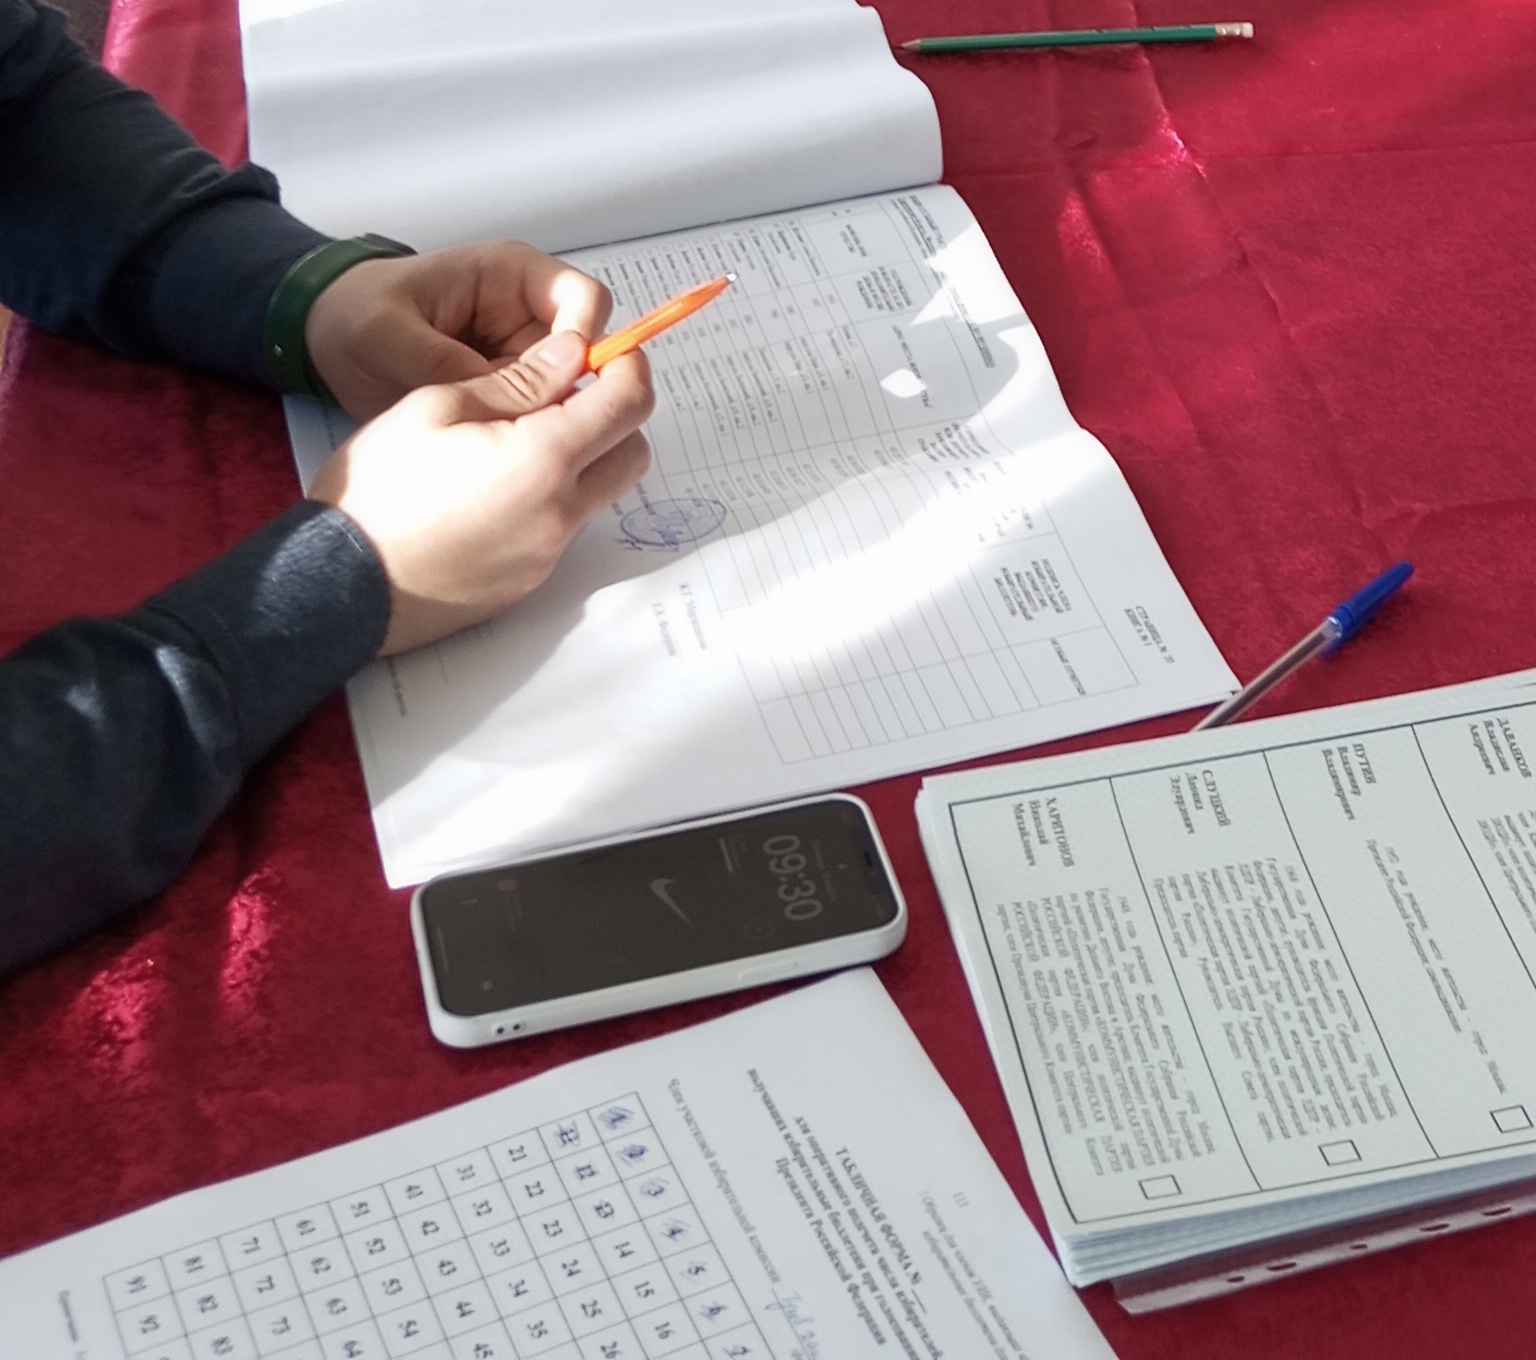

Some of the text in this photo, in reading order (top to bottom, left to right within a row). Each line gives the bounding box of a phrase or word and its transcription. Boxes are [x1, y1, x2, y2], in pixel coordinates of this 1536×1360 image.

[1322, 749, 1354, 819] Владимирович
[1338, 747, 1361, 795] Владимир
[1353, 744, 1376, 783] ПУТИН
[1471, 725, 1495, 774] Андреевич
[1484, 721, 1510, 771] Владислав
[1497, 718, 1531, 777] ДАВАНКОВ
[1014, 803, 1035, 865] Михайлович
[1029, 801, 1048, 844] Николай
[1047, 798, 1074, 867] ХАРИТОНОВ
[1171, 776, 1195, 834] Эдуардович
[1186, 773, 1203, 810] Леонид
[1203, 770, 1230, 826] СЛУЦКИЙ
[762, 833, 824, 922] 09:30
[668, 1079, 780, 1283] Член участковой избирательной комиссии
[748, 1069, 787, 1131] получивших
[784, 1133, 831, 1210] избирательные
[829, 1212, 866, 1270] бюллетени
[863, 1272, 879, 1292] при
[808, 1136, 850, 1206] оперативного
[848, 1208, 879, 1255] подсчета
[878, 1257, 898, 1289] числа
[836, 1148, 886, 1222] ТАБЛИЧНАЯ
[881, 1224, 912, 1270] ФОРМА
[245, 1237, 290, 1334] 71 72 73
[297, 1220, 362, 1358] 61 62 63 64
[352, 1202, 418, 1338] 51 52 53 54
[406, 1186, 493, 1358] 41 42 43 44 45
[457, 1165, 548, 1338] 31 32 33 34 35
[509, 1146, 619, 1358] 21 22 23 24 25 26
[615, 1242, 633, 1258] 14
[635, 1282, 654, 1297] 15
[655, 1322, 670, 1339] 16
[776, 1158, 886, 1345] Президента Российской Федерации
[128, 1277, 159, 1333] 91 92
[186, 1257, 232, 1354] 81 82 83
